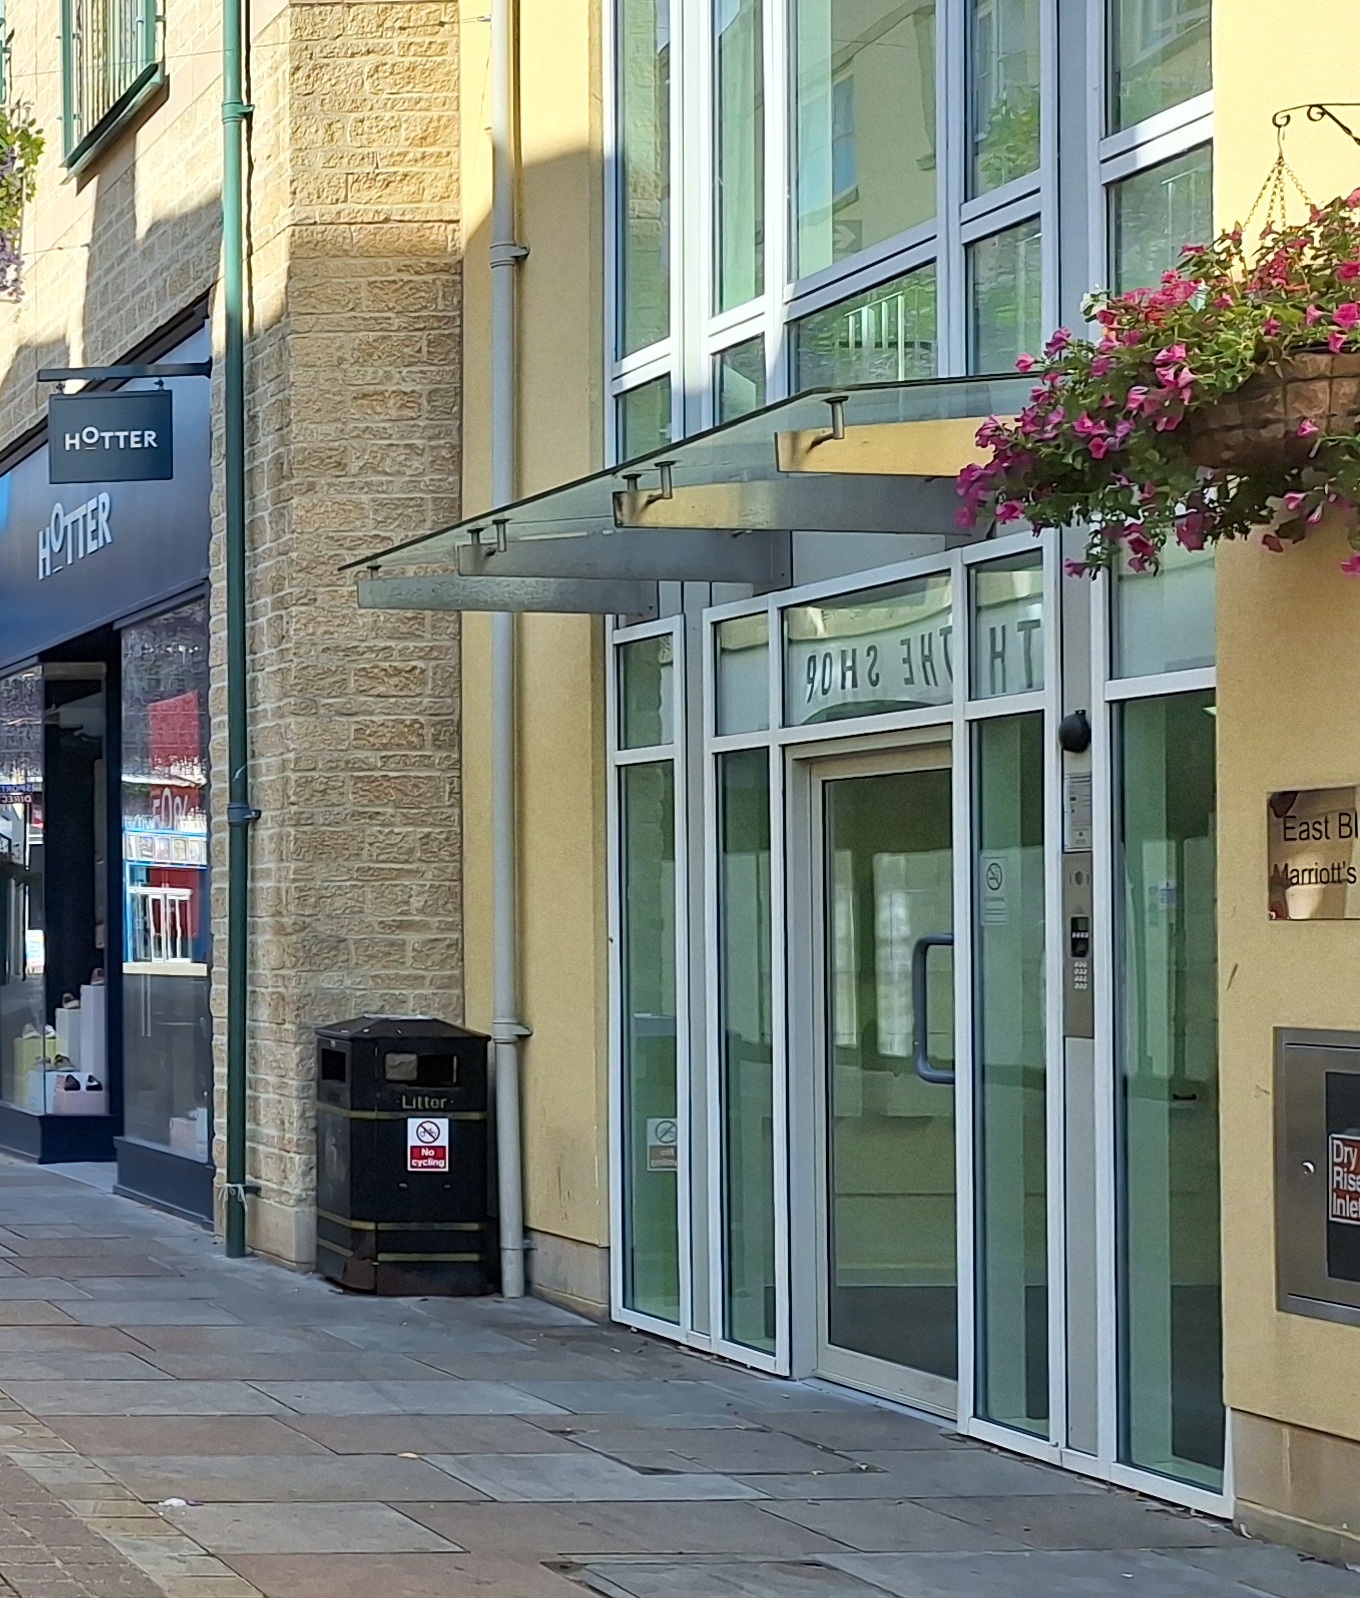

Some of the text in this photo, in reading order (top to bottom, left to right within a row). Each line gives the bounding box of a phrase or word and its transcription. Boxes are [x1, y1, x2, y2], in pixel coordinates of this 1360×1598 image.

[65, 426, 158, 451] HOTTER
[38, 492, 113, 580] HOTTER
[1283, 812, 1358, 841] East Bl
[1273, 861, 1357, 886] Marriott's
[401, 1094, 448, 1110] Litter
[411, 1158, 446, 1168] cycling
[420, 1147, 435, 1157] No
[1333, 1139, 1358, 1172] Dry
